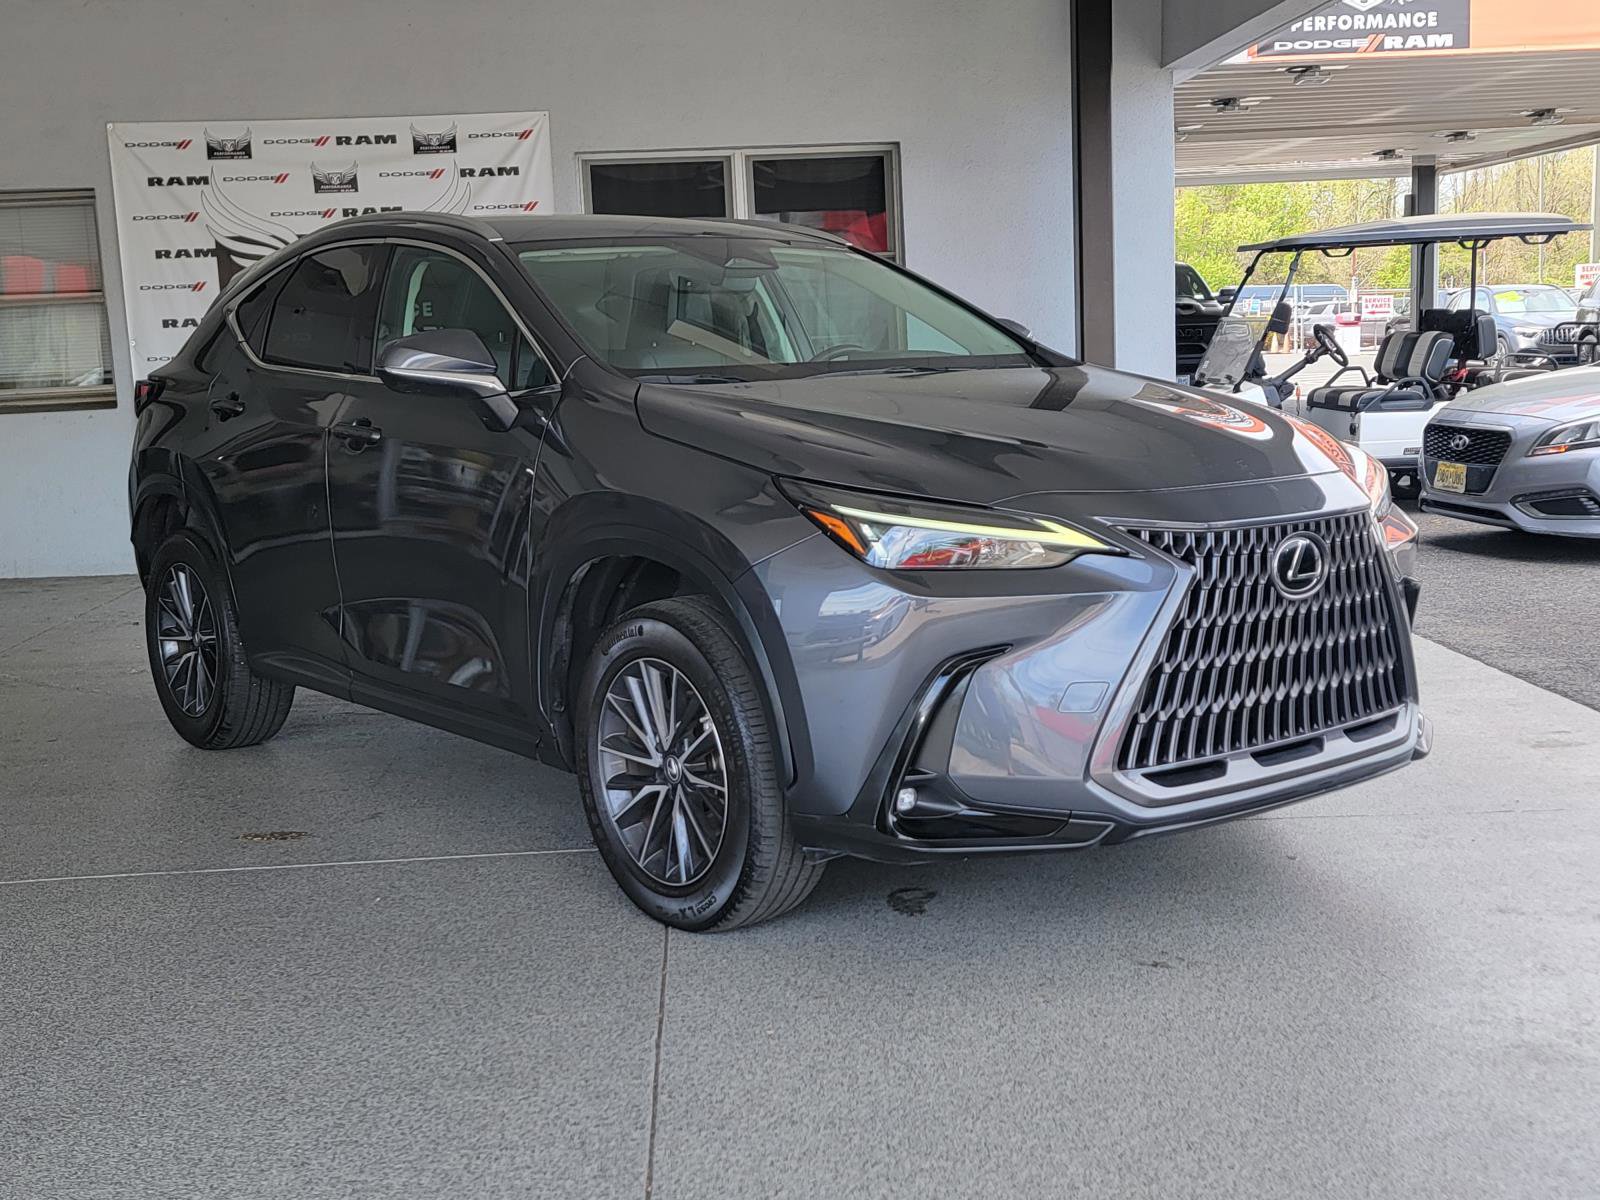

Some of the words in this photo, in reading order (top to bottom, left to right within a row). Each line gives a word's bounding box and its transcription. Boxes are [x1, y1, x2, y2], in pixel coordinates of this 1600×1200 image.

[1291, 12, 1438, 32] PERFORMANCE
[1274, 38, 1370, 51] DODGE
[1384, 33, 1454, 49] RAM
[335, 134, 398, 146] RAM
[459, 166, 520, 178] RAM
[147, 175, 210, 187] RAM
[342, 206, 403, 217] RAM
[155, 247, 218, 259] RAM
[162, 318, 199, 329] RA
